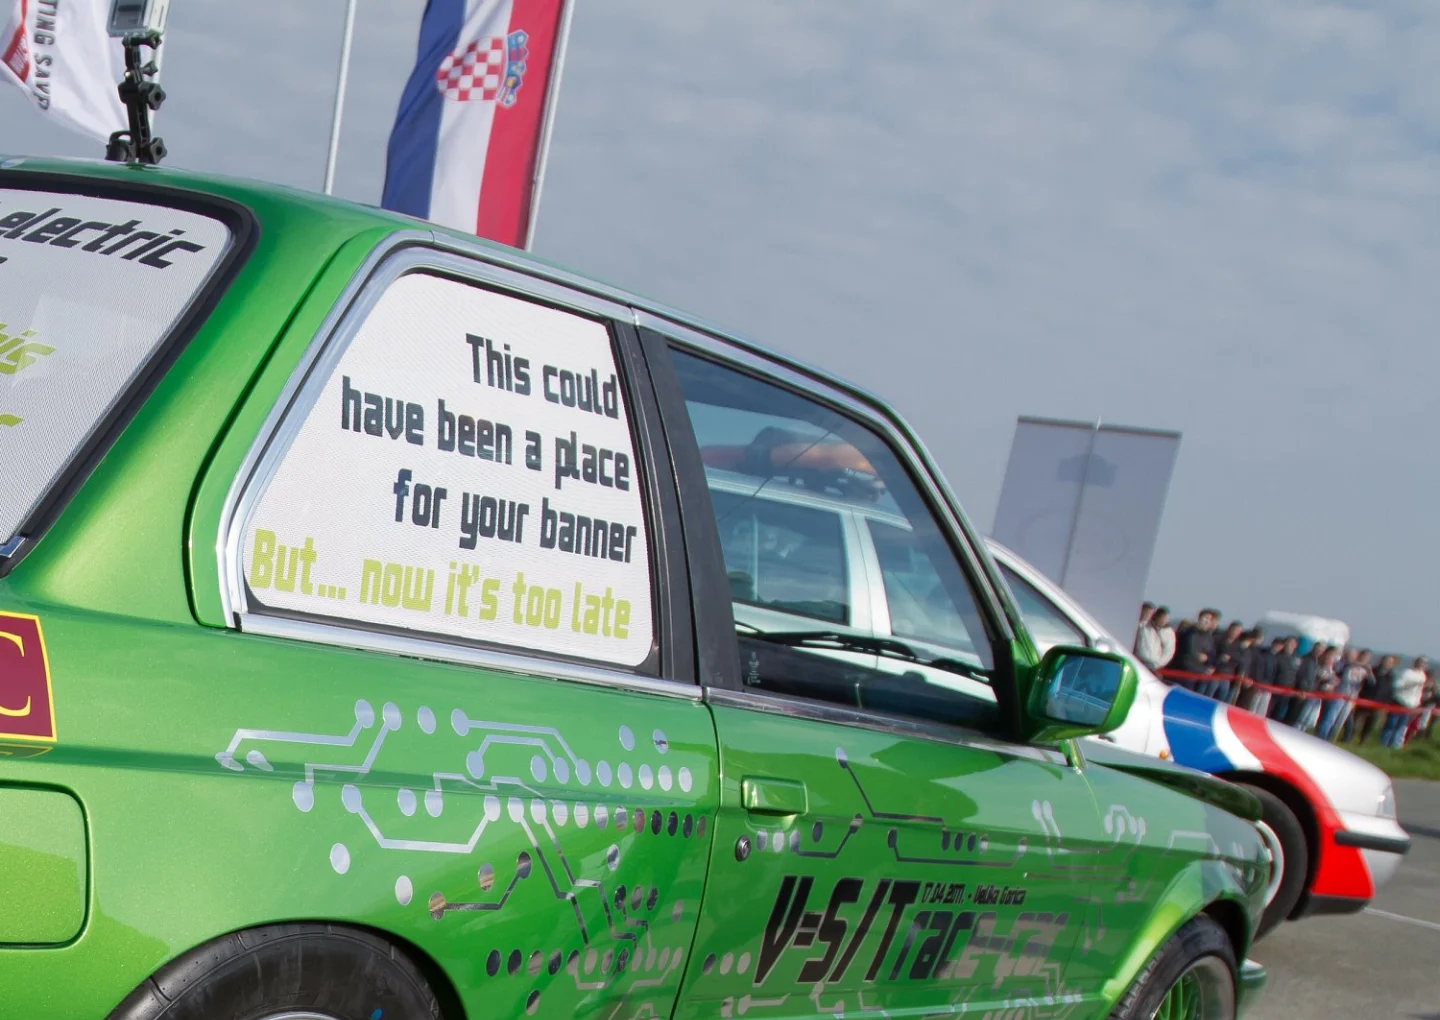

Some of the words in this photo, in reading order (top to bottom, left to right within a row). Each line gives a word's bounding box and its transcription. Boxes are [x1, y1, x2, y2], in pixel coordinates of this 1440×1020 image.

[465, 332, 531, 397] This
[543, 364, 619, 420] could
[341, 375, 424, 446] have
[438, 398, 512, 465] been
[525, 429, 542, 471] a
[554, 430, 630, 491] place
[393, 468, 447, 529] for
[459, 491, 529, 550] your
[539, 497, 637, 563] banner
[249, 528, 347, 600] But...
[360, 558, 435, 612] now
[445, 560, 501, 621] it's
[512, 571, 562, 630] too
[571, 582, 631, 640] late
